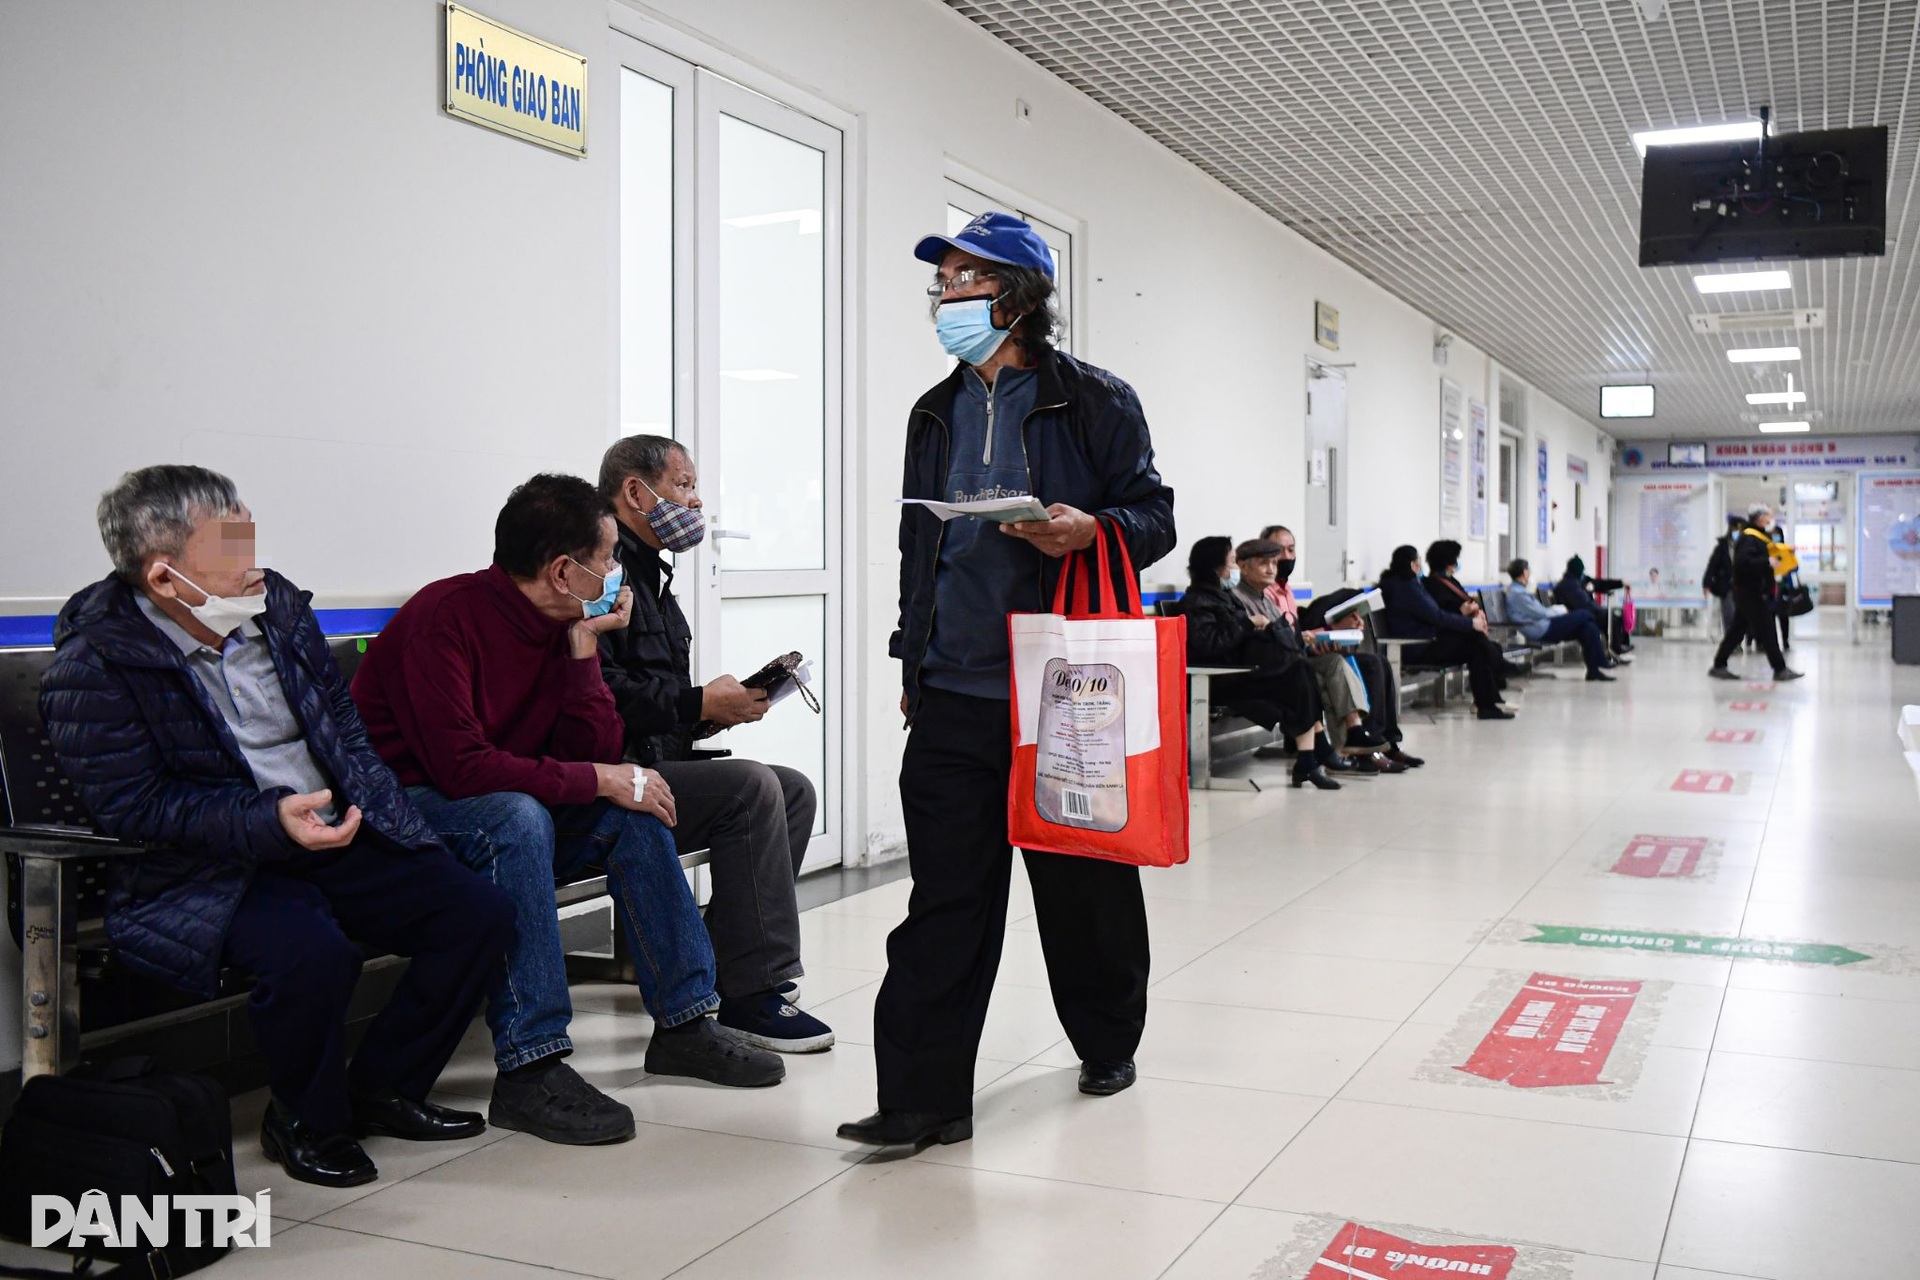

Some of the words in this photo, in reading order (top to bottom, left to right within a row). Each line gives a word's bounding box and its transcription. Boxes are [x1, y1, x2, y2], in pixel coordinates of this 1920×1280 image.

[456, 38, 507, 107] PHÒNG
[512, 65, 547, 121] GIAO
[551, 80, 580, 132] BAN
